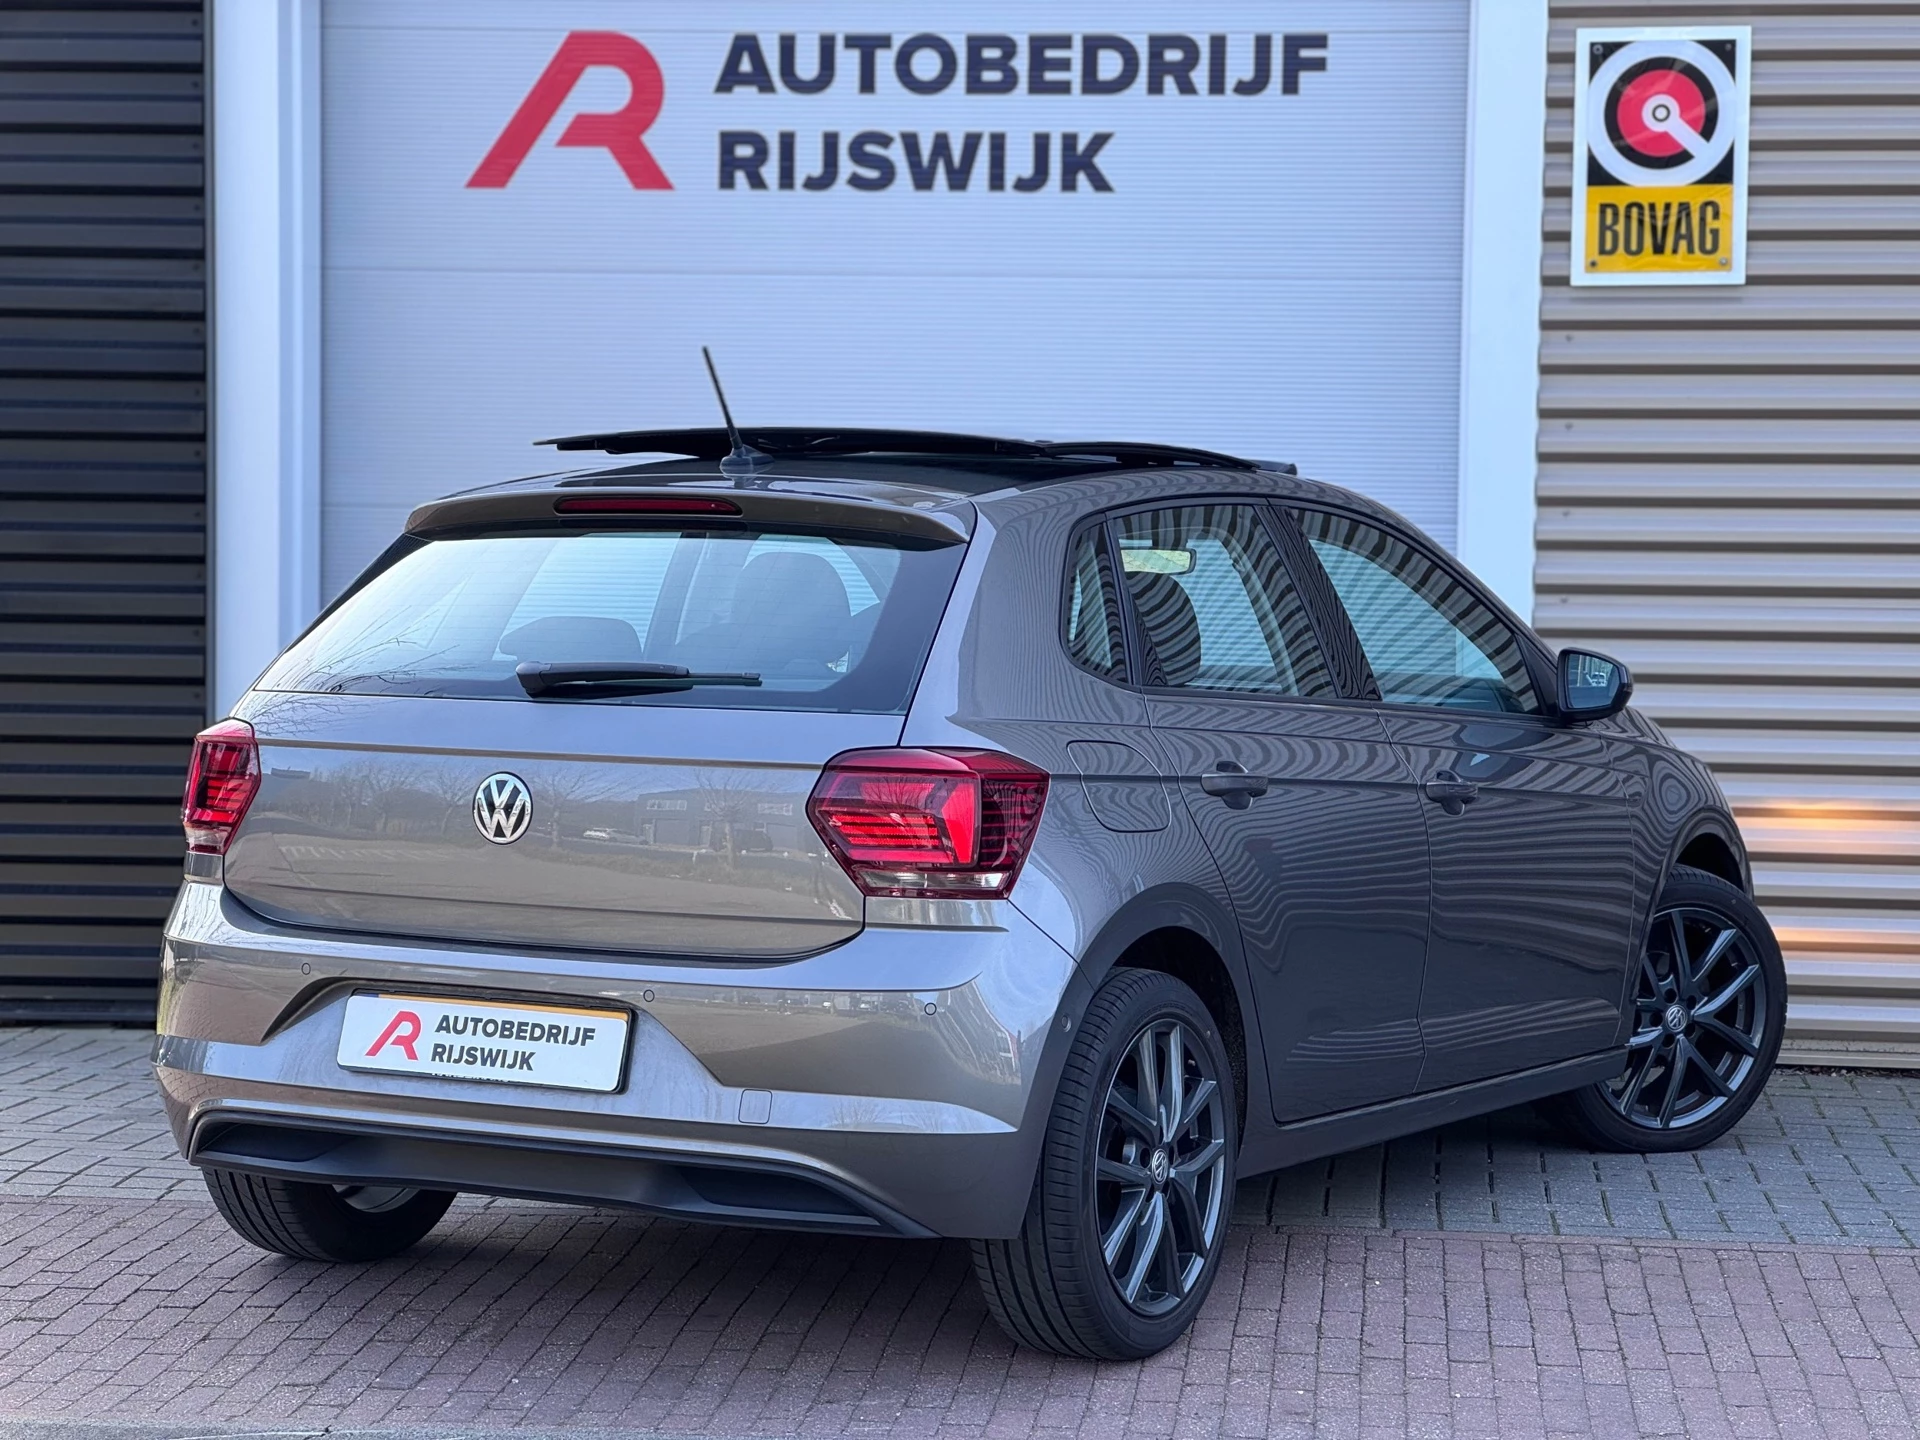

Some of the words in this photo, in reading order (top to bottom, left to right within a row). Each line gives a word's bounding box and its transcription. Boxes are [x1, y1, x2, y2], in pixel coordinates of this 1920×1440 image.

[715, 33, 1328, 96] AUTOBEDRIJF
[718, 130, 1115, 193] RIJSWIJK
[1597, 200, 1721, 256] BOVAG
[474, 773, 531, 843] VW
[430, 1043, 536, 1072] RIJSWIJK
[434, 1014, 596, 1047] AUTOBEDRIJF
